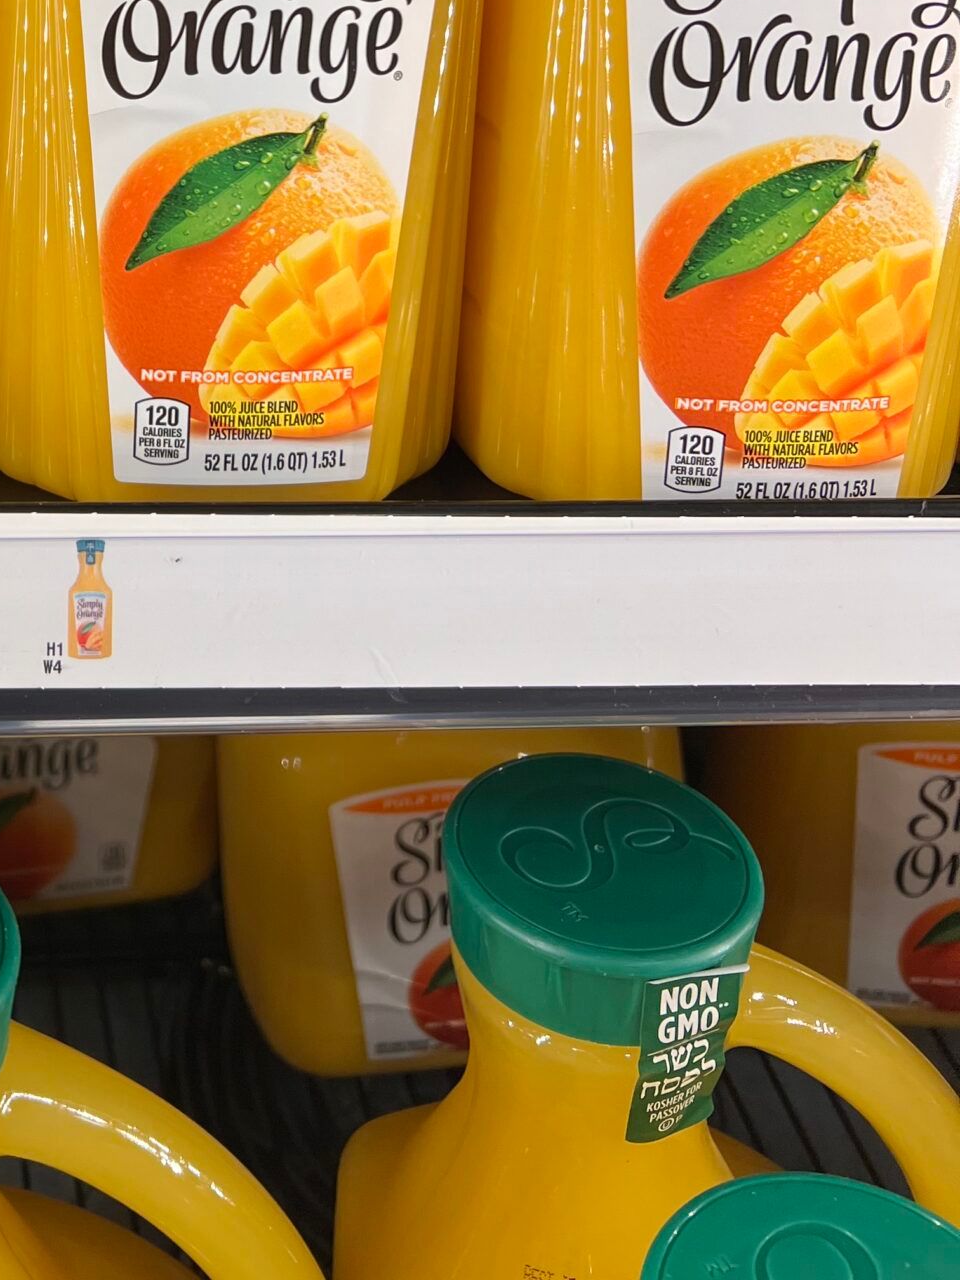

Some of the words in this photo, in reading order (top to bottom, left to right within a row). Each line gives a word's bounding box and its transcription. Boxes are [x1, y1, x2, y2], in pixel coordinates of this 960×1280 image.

[648, 13, 957, 132] Orange
[145, 405, 180, 426] 120
[208, 428, 273, 441] PASTEURIZED
[679, 434, 714, 455] 120
[742, 456, 806, 470] PASTEURIZED
[46, 642, 63, 656] H1
[43, 660, 63, 674] W4
[660, 977, 719, 1016] NON
[658, 1006, 719, 1044] GMO
[647, 1093, 684, 1113] KOSHER
[685, 1081, 702, 1097] FOR
[650, 1094, 695, 1123] PASSOVER
